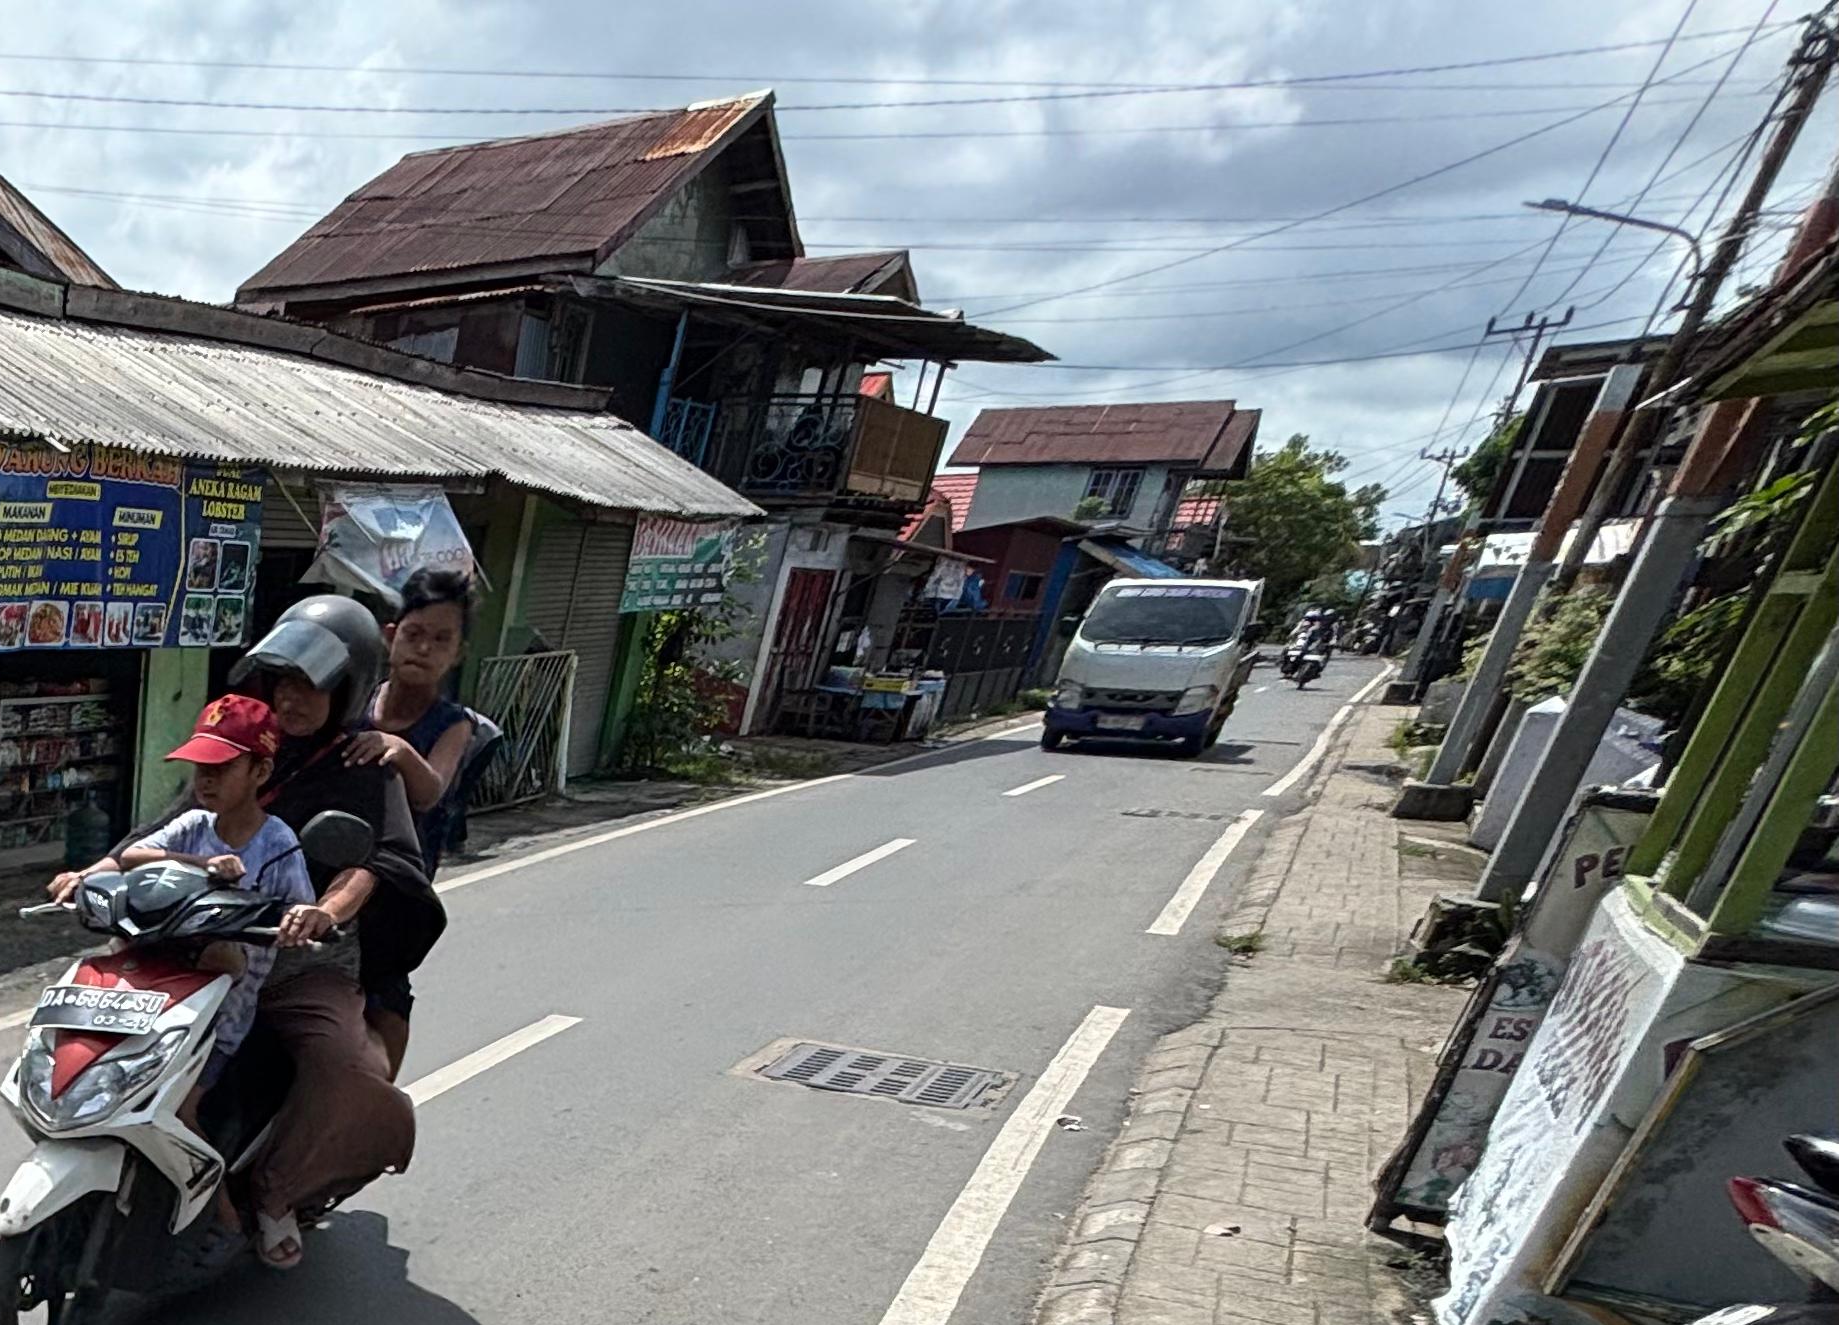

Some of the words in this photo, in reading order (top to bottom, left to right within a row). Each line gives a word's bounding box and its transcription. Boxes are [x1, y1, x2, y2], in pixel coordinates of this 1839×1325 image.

[189, 478, 225, 497] ANEKA
[2, 505, 46, 519] MAKANAN
[202, 500, 245, 519] LOBSTER
[41, 989, 66, 1007] DA
